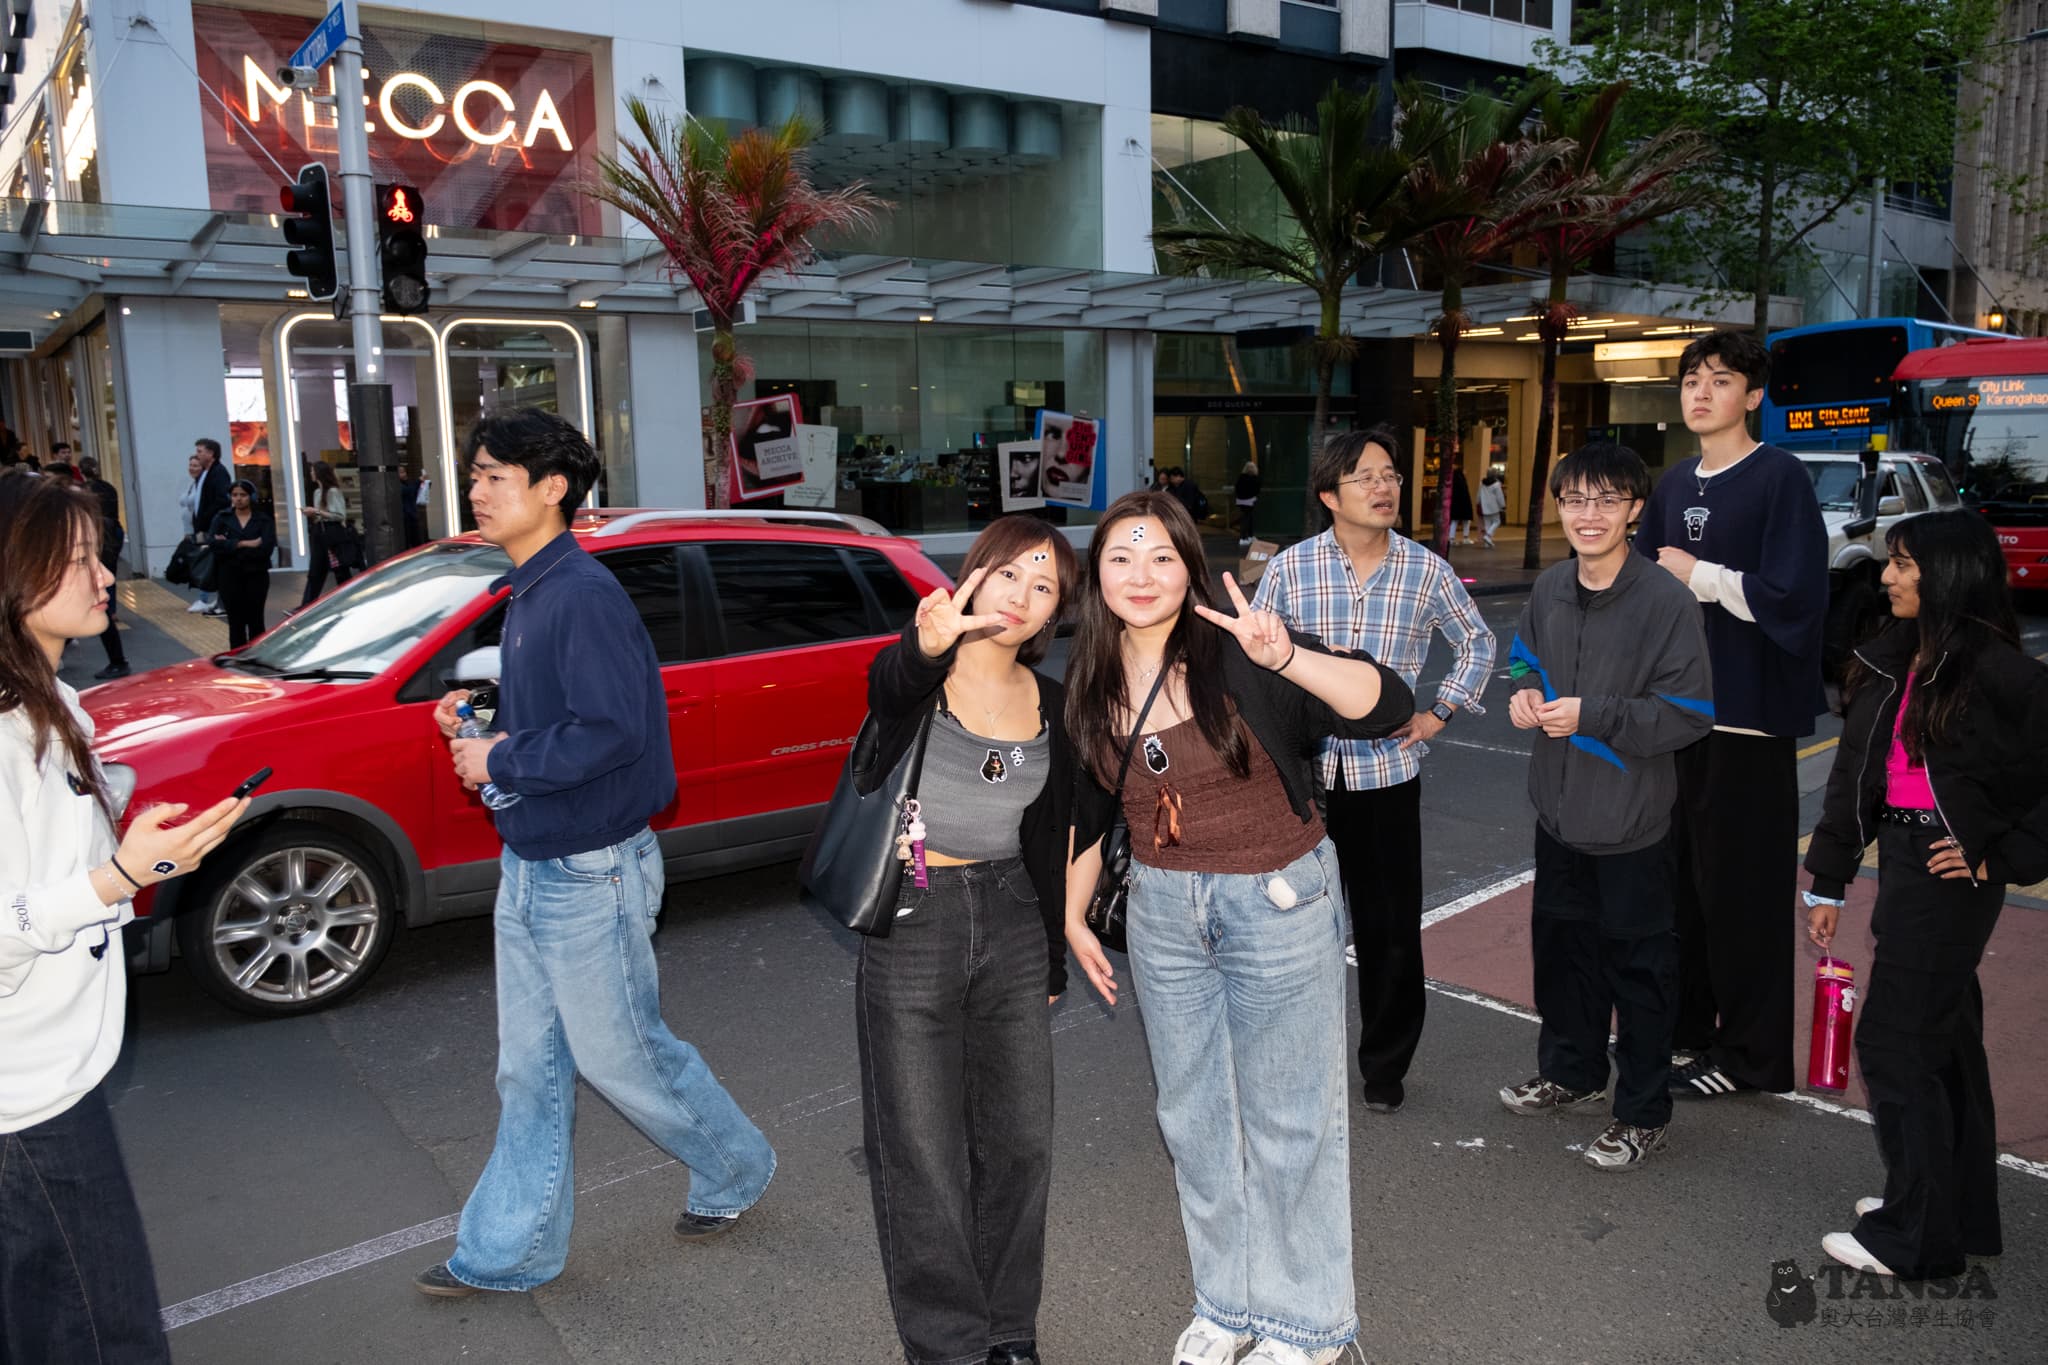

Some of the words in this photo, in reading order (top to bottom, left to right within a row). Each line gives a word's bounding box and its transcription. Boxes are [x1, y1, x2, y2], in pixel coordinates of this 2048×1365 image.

[1980, 381, 2000, 393] City
[2002, 379, 2025, 392] Link
[1932, 395, 1965, 409] Queen
[1967, 394, 1980, 406] St
[1819, 409, 1839, 421] City
[764, 444, 793, 456] MECCA
[761, 452, 798, 465] ARCHIVE
[1997, 534, 2019, 545] tro
[771, 742, 817, 756] CROSS
[819, 736, 857, 748] POLO
